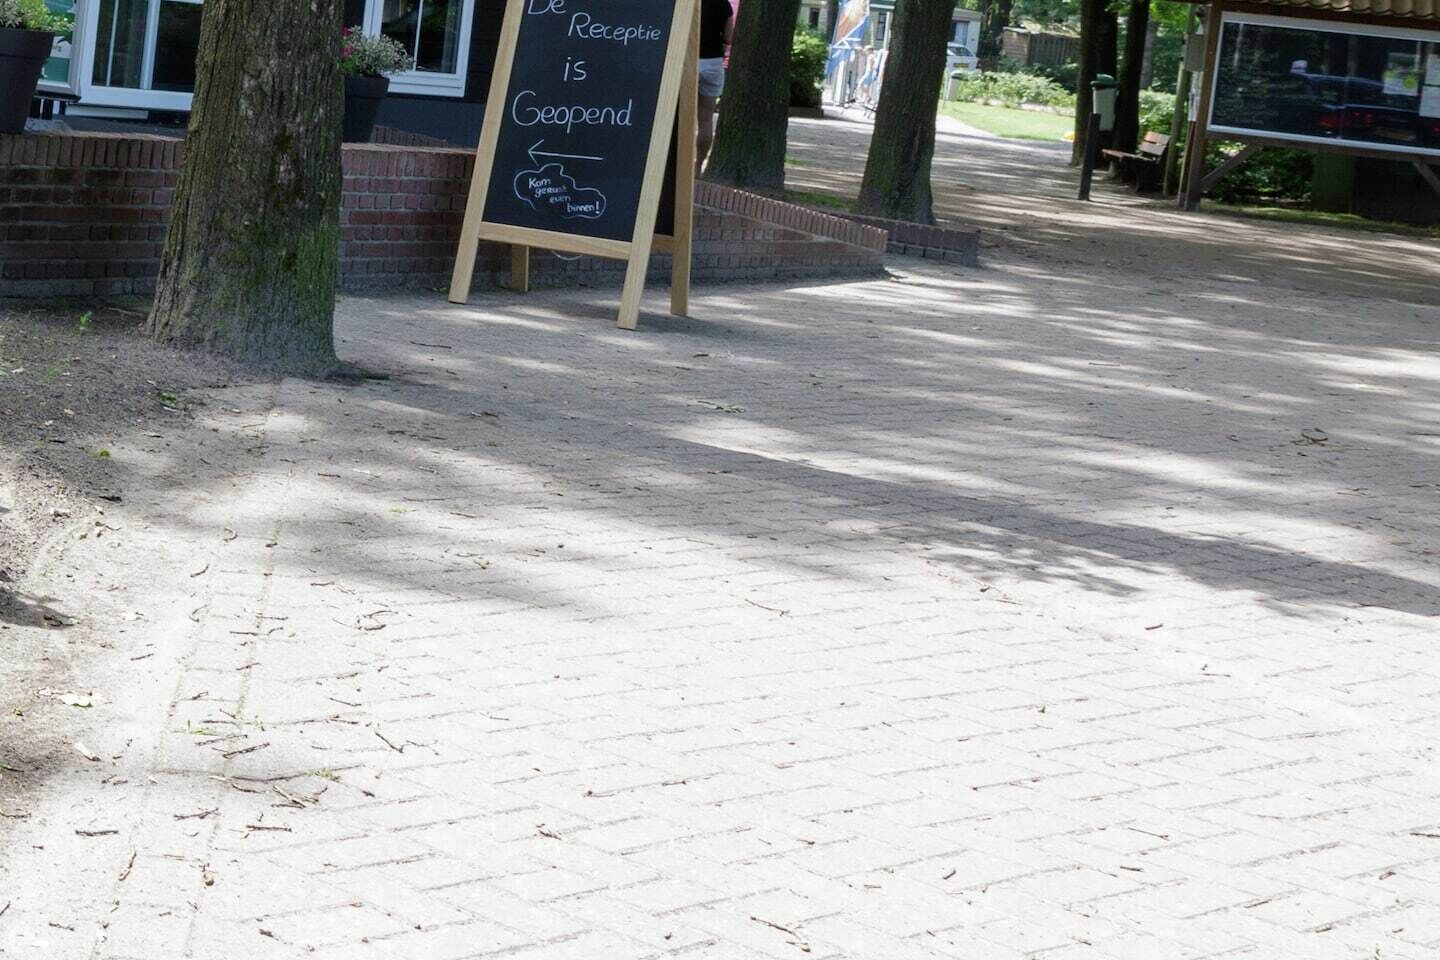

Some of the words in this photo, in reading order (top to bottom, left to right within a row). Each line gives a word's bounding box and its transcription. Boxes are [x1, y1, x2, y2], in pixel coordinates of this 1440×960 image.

[568, 12, 661, 46] Receptie
[563, 57, 587, 82] is
[512, 90, 633, 134] Geopend
[528, 178, 551, 189] Kom
[567, 201, 600, 214] binnen!
